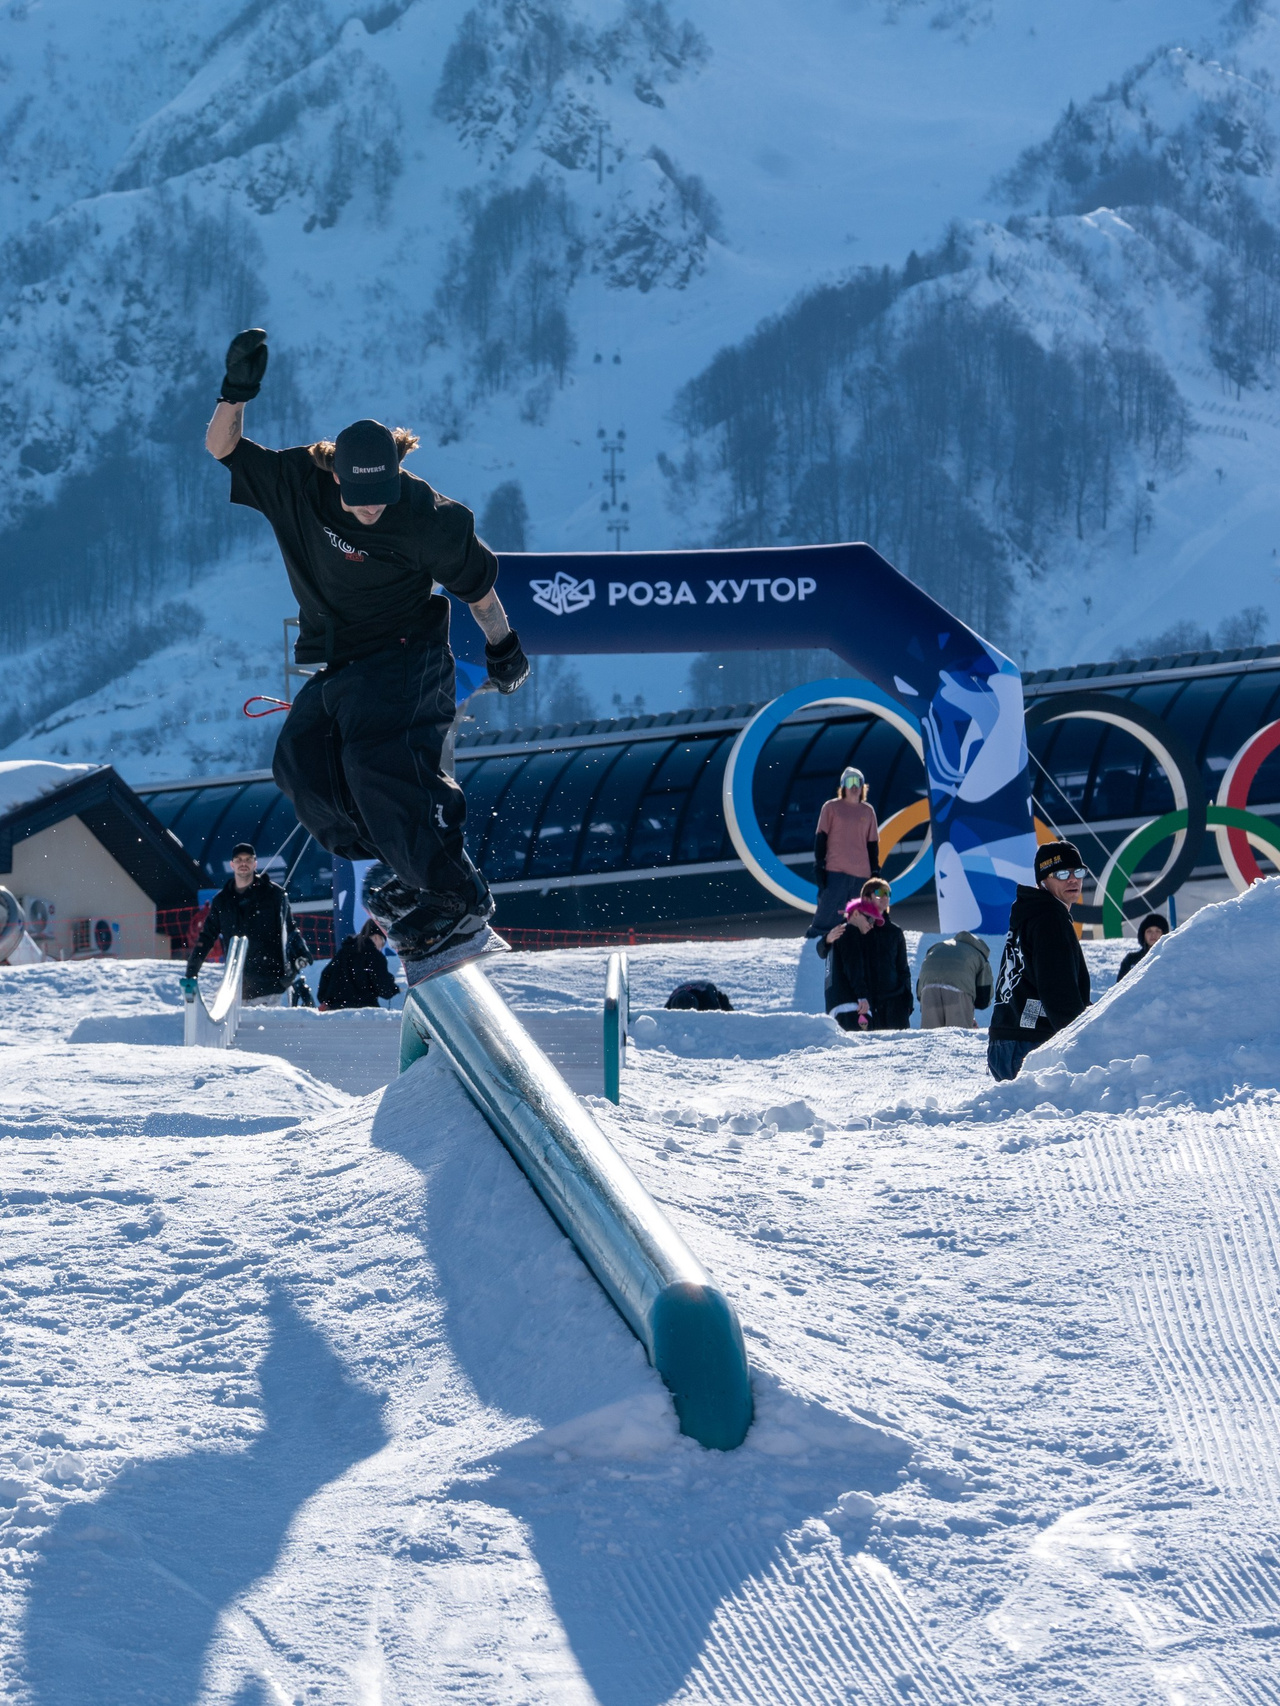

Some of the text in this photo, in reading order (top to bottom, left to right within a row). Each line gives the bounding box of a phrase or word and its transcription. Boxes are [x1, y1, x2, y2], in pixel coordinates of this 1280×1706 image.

[359, 464, 386, 474] REVERSE
[608, 577, 817, 606] РОЗА ХУТОР
